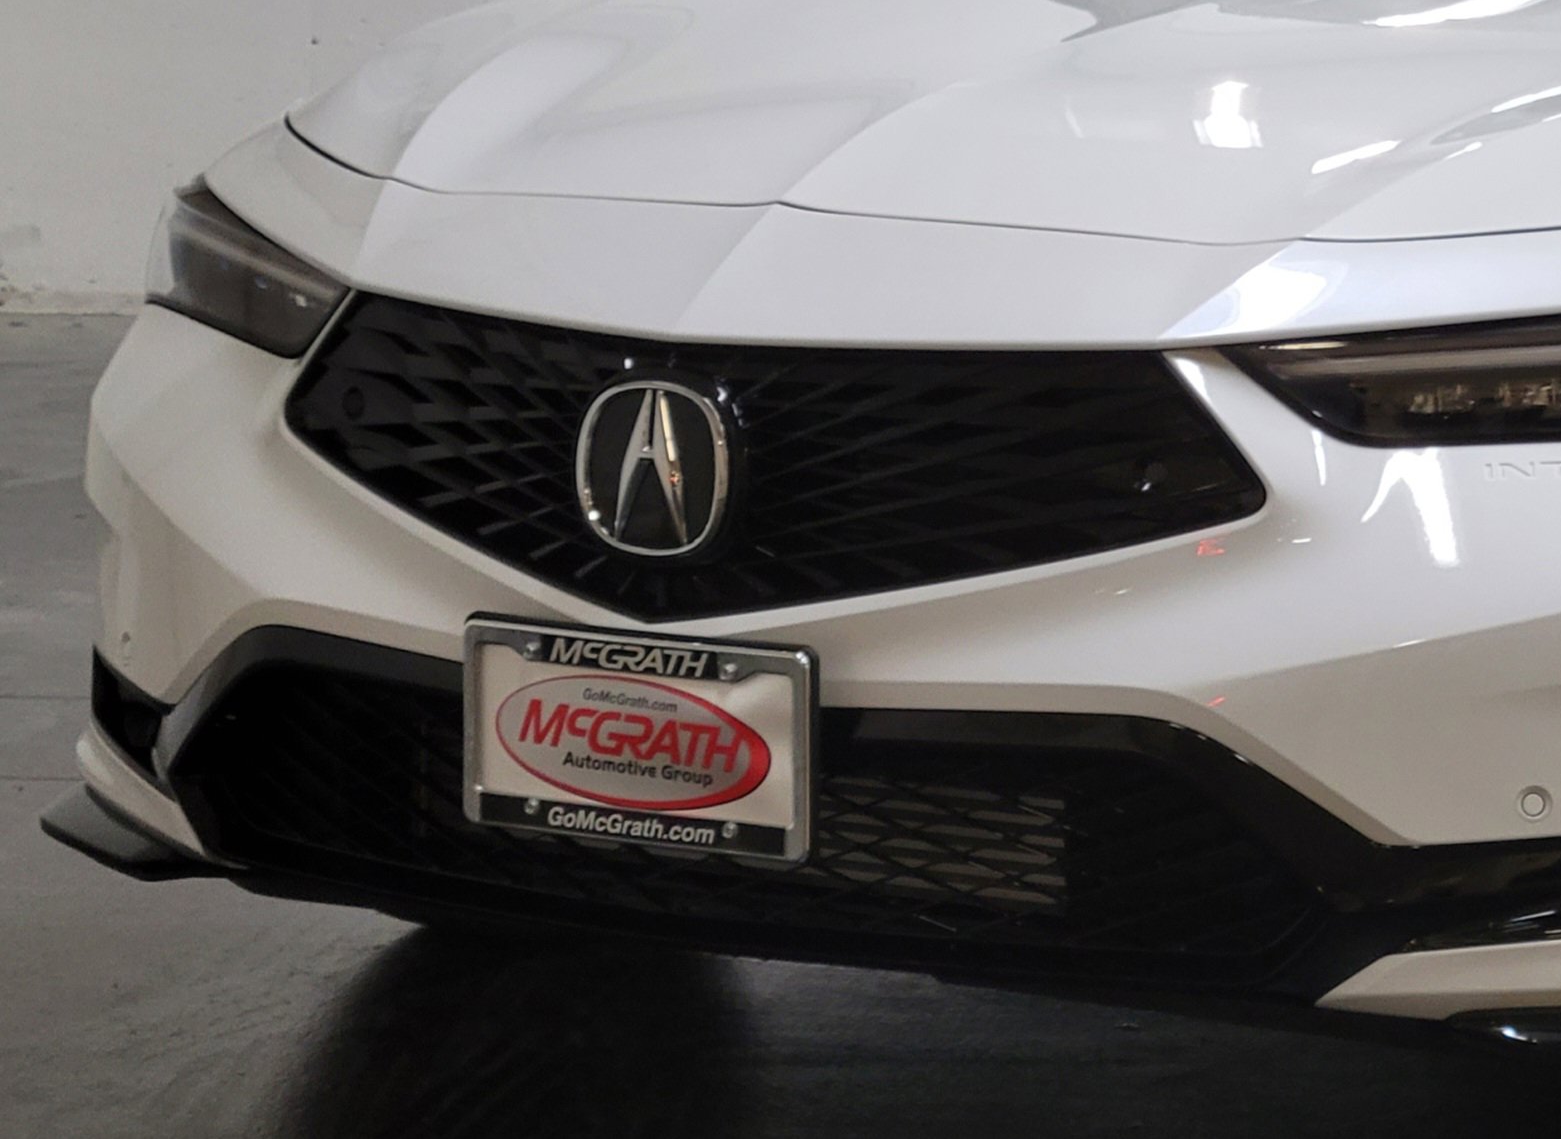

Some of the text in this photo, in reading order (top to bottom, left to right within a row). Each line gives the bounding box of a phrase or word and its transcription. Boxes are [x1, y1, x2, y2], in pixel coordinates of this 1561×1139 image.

[582, 687, 678, 713] GoMcGrath.com
[562, 750, 714, 788] Automotive Group
[547, 806, 715, 845] GoMcGrath.com
